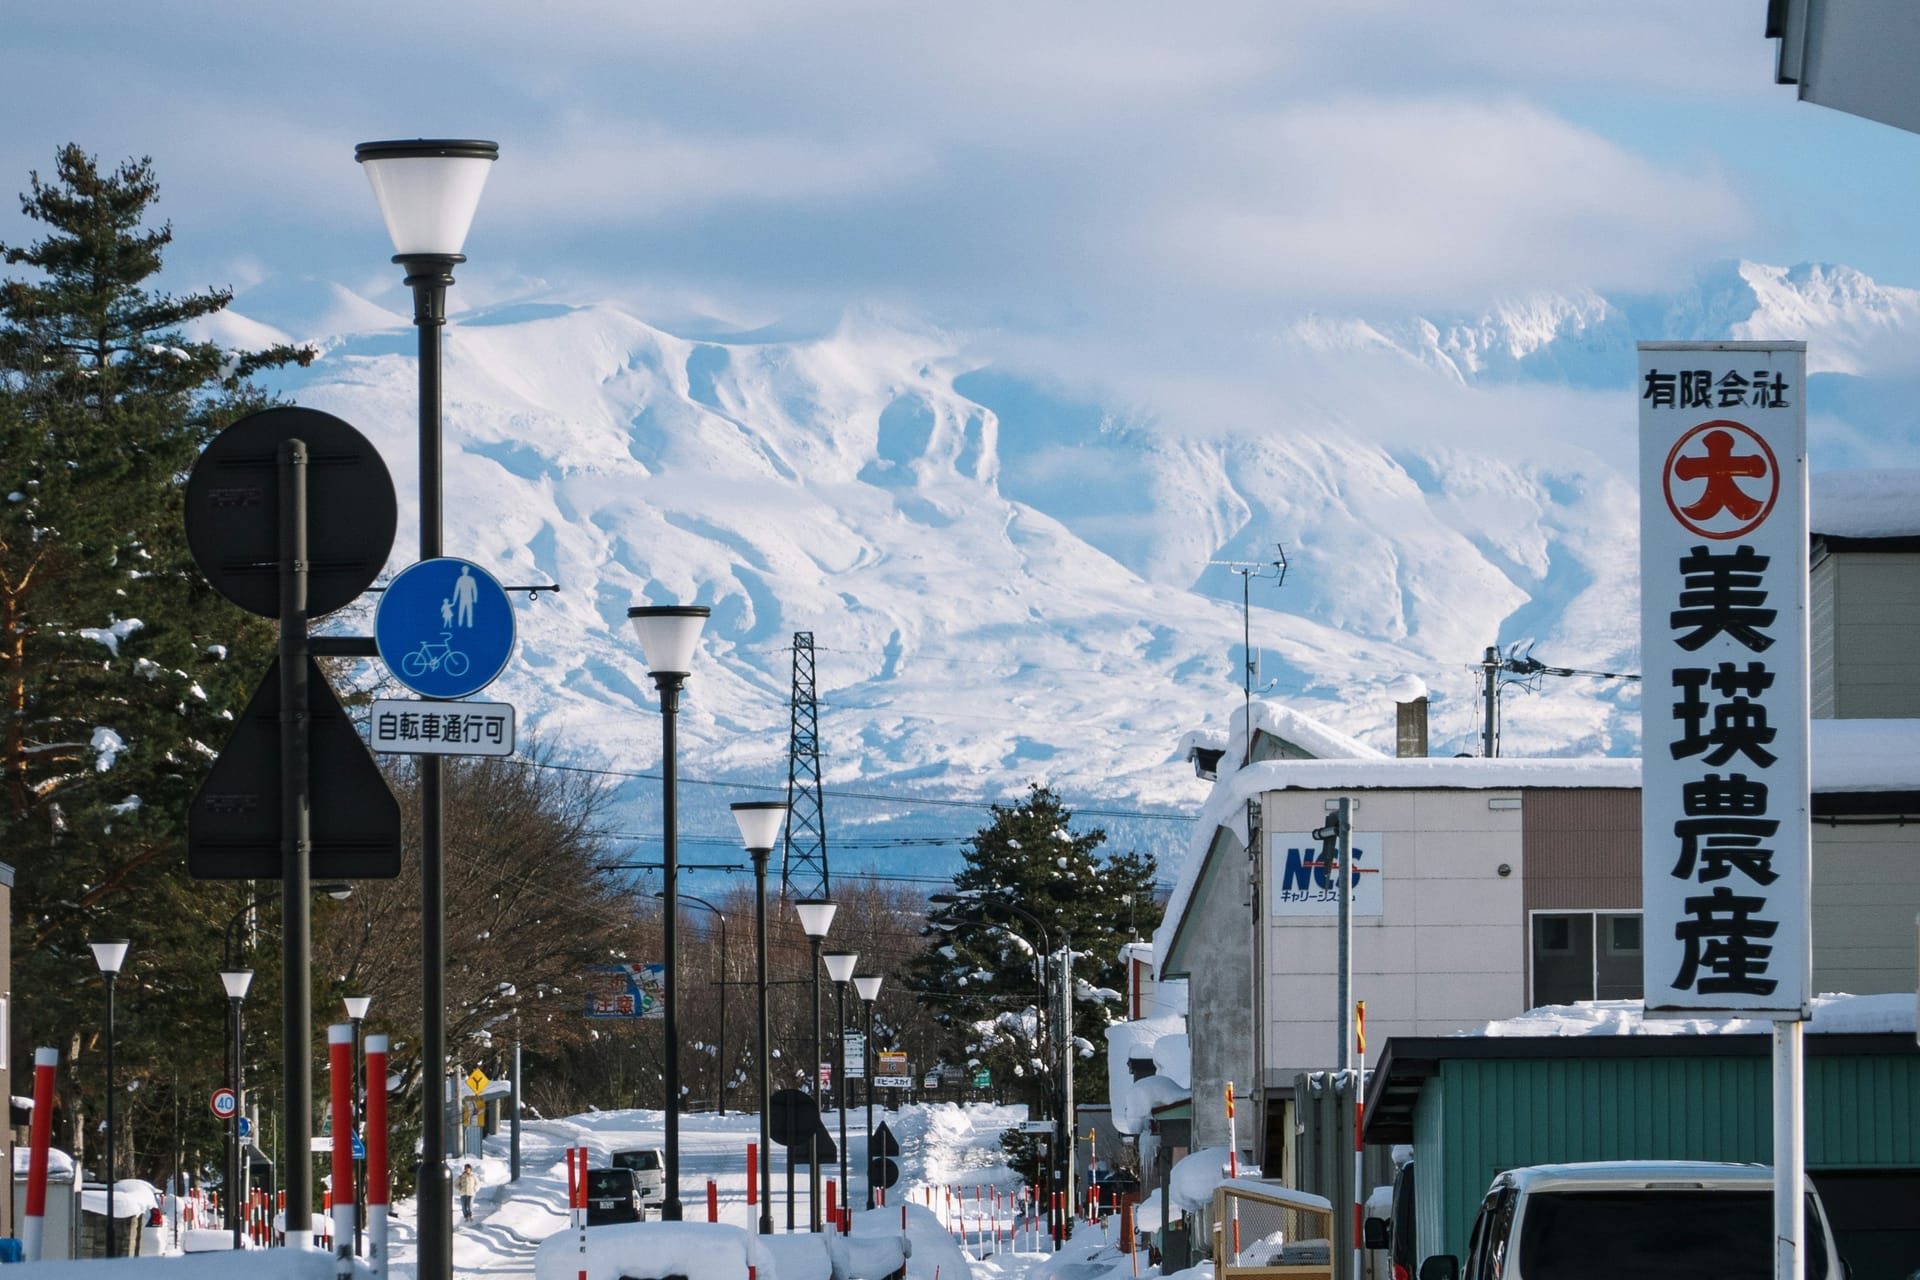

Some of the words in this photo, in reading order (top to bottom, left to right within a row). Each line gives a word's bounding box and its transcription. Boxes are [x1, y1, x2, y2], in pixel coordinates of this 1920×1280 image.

[1643, 369, 1792, 409] 有限会社
[1674, 430, 1767, 521] 大
[378, 711, 506, 744] 自転車通行可
[1670, 545, 1781, 996] 美瑛農産
[1282, 848, 1363, 891] NCS
[1281, 891, 1356, 902] キャリーシス
[217, 1096, 233, 1110] 40
